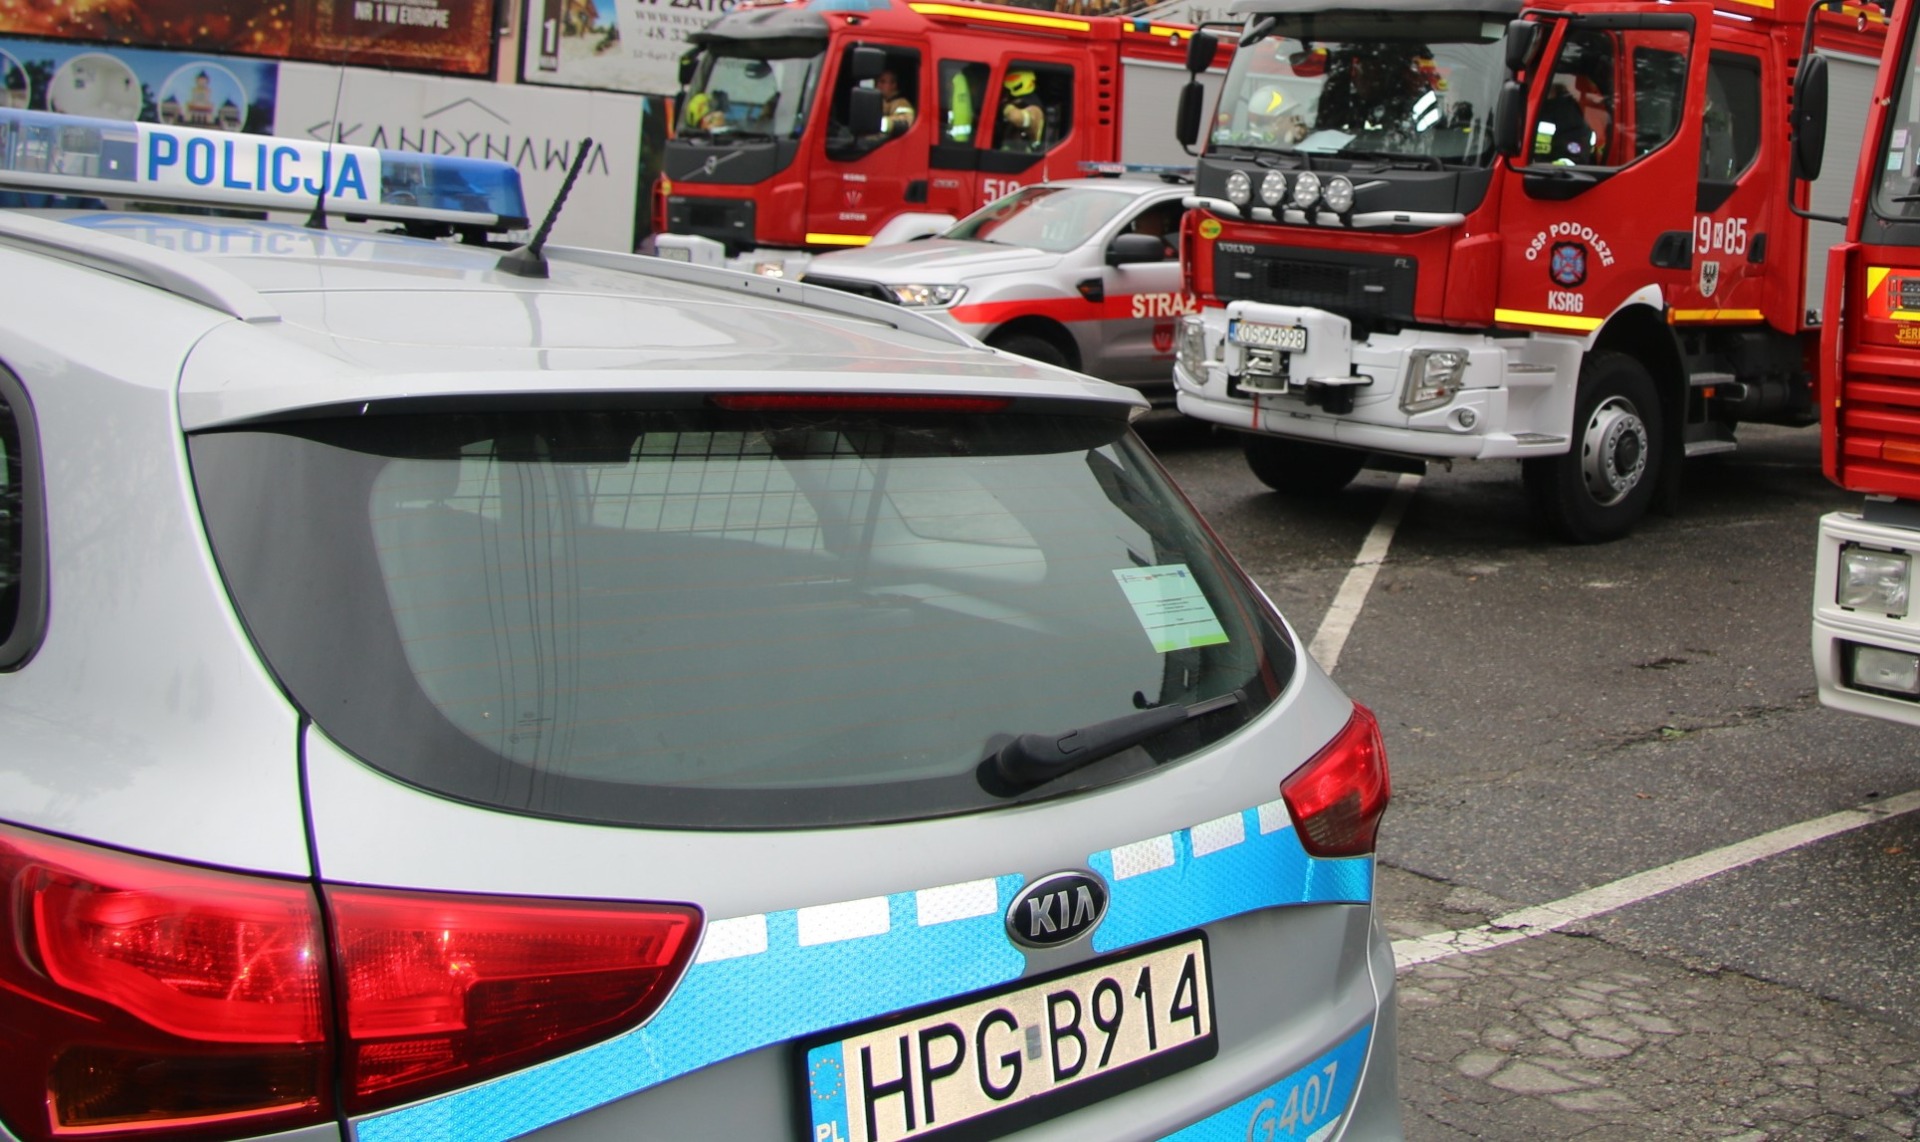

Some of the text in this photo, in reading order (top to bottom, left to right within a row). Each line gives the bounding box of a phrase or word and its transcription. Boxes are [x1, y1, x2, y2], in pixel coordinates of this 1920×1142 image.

[544, 18, 557, 54] 1
[148, 131, 368, 200] POLICJA
[1218, 242, 1256, 254] VOLVO
[1525, 222, 1615, 267] OSP PODOLSZE
[1547, 290, 1584, 313] KSRG
[1895, 327, 1920, 341] PER
[1028, 885, 1096, 937] KIA
[1246, 1060, 1338, 1142] G407
[815, 1120, 845, 1142] PL
